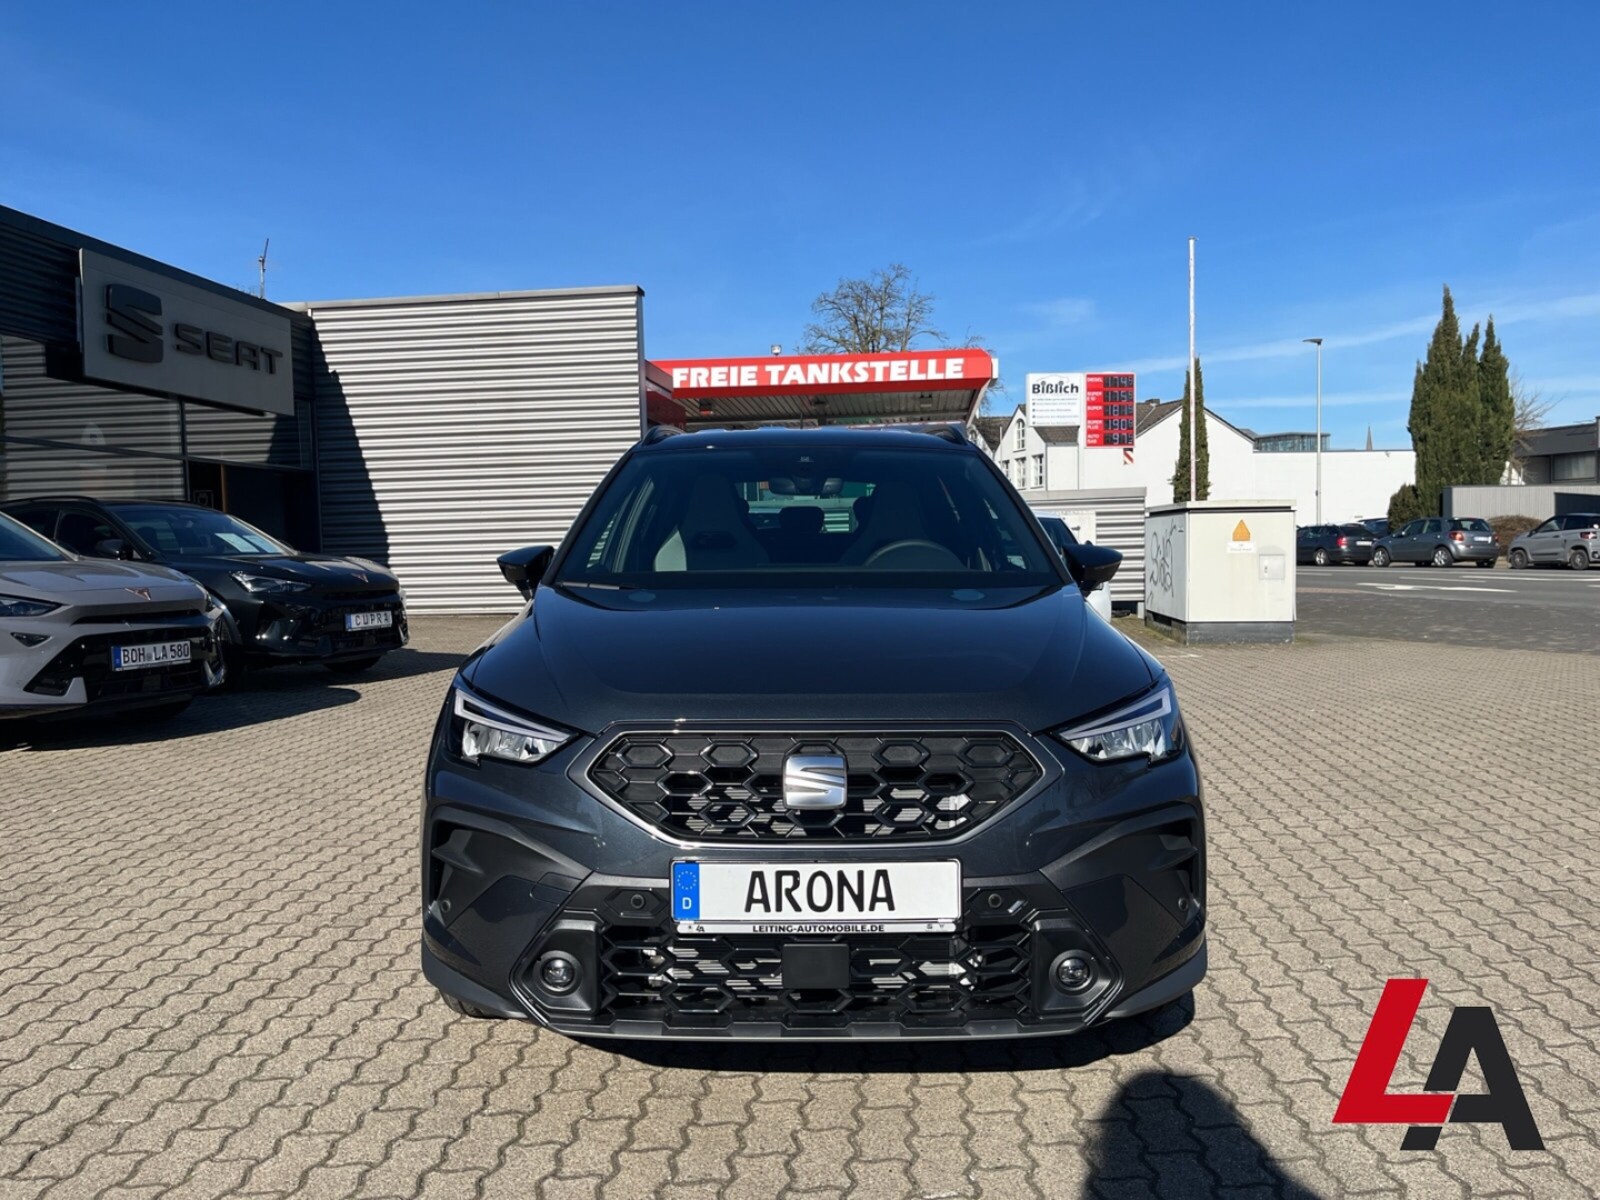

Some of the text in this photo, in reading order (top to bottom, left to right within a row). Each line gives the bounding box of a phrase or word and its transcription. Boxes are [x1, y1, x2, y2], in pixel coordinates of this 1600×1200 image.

[174, 322, 284, 376] SEAT
[672, 357, 965, 389] FREIE TANKSTELLE
[1032, 380, 1079, 394] Bißlich
[355, 611, 391, 626] CUPRA
[122, 647, 146, 664] BOH
[153, 645, 168, 661] LA
[170, 643, 190, 659] 580
[744, 869, 896, 913] ARONA
[681, 897, 692, 910] D
[752, 925, 885, 933] LEITING-AUTOMOBILE.DE
